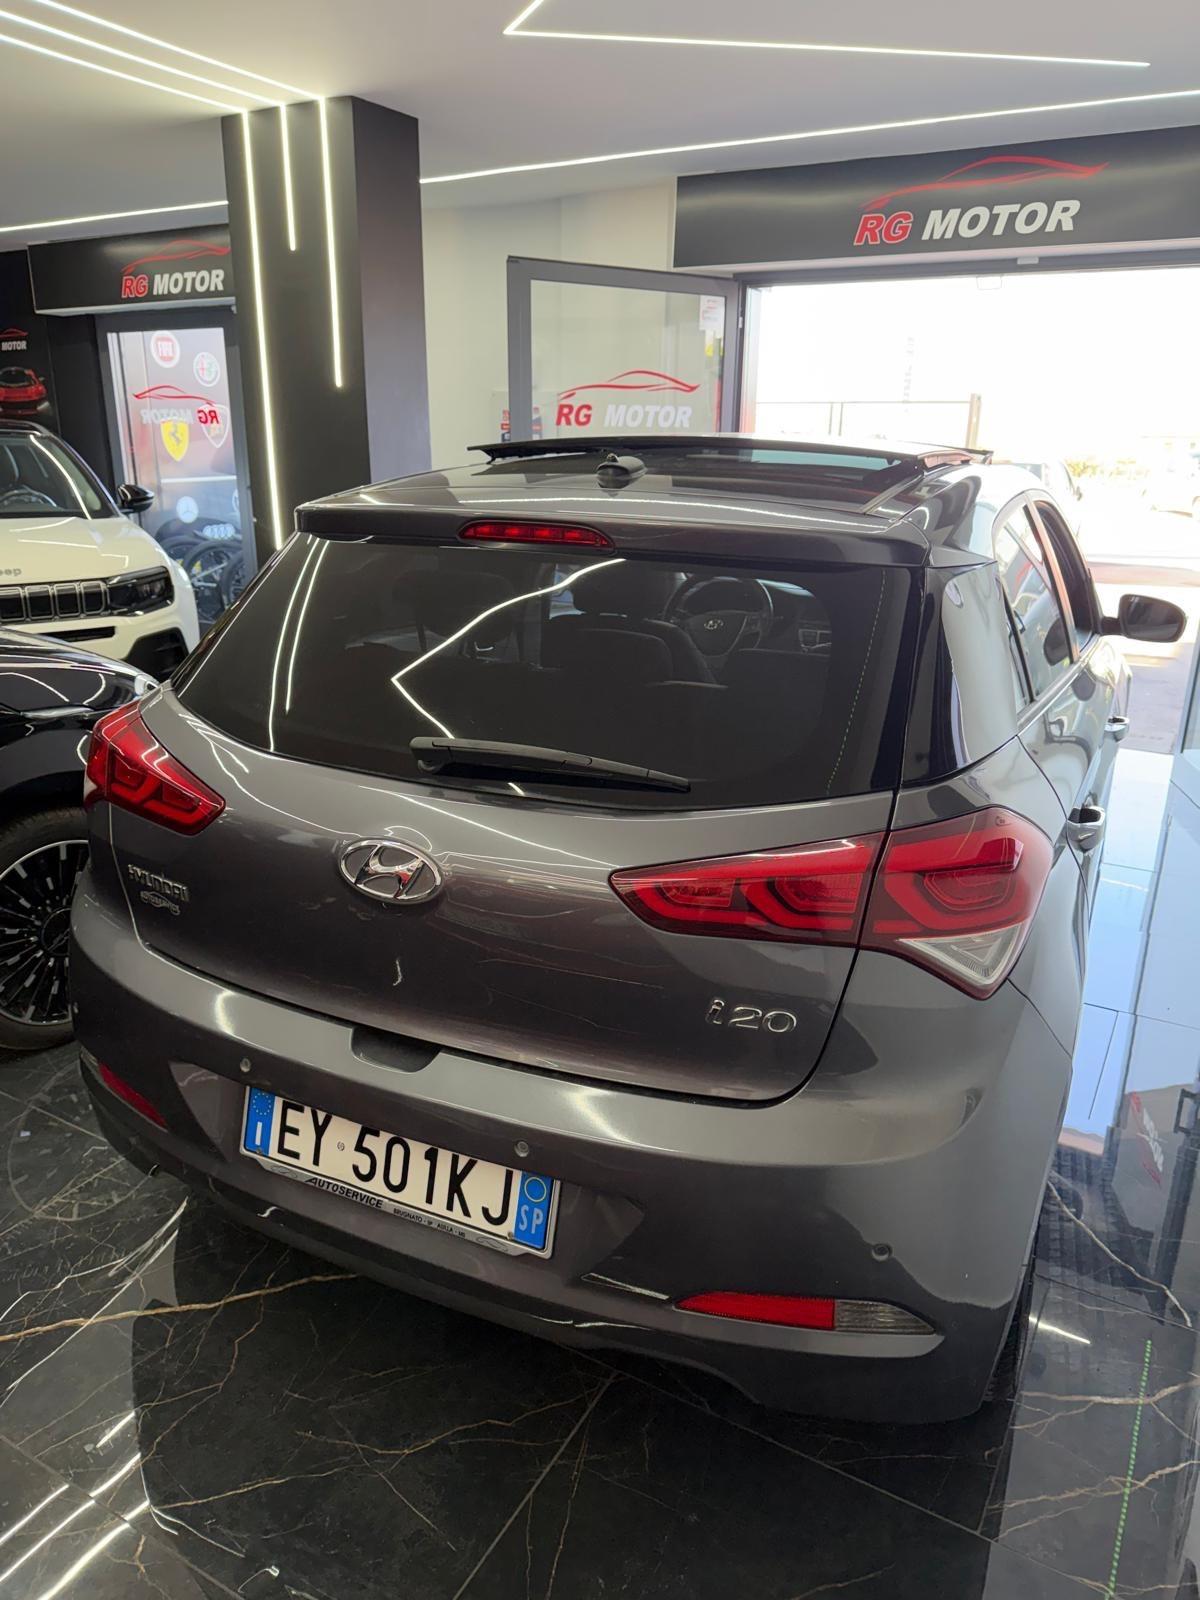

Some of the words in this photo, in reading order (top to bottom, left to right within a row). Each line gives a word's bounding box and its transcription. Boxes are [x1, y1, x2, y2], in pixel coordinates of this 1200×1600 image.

[853, 210, 913, 246] RG
[921, 199, 1081, 241] MOTOR
[121, 274, 149, 298] RG
[152, 269, 225, 296] MOTOR
[1, 340, 28, 351] MOTOR
[555, 403, 593, 427] RG
[603, 404, 693, 428] MOTOR
[277, 1099, 333, 1167] EY
[351, 1124, 514, 1226] 501KJ
[304, 1176, 384, 1209] AUTOSERVICE
[518, 1204, 544, 1235] SP
